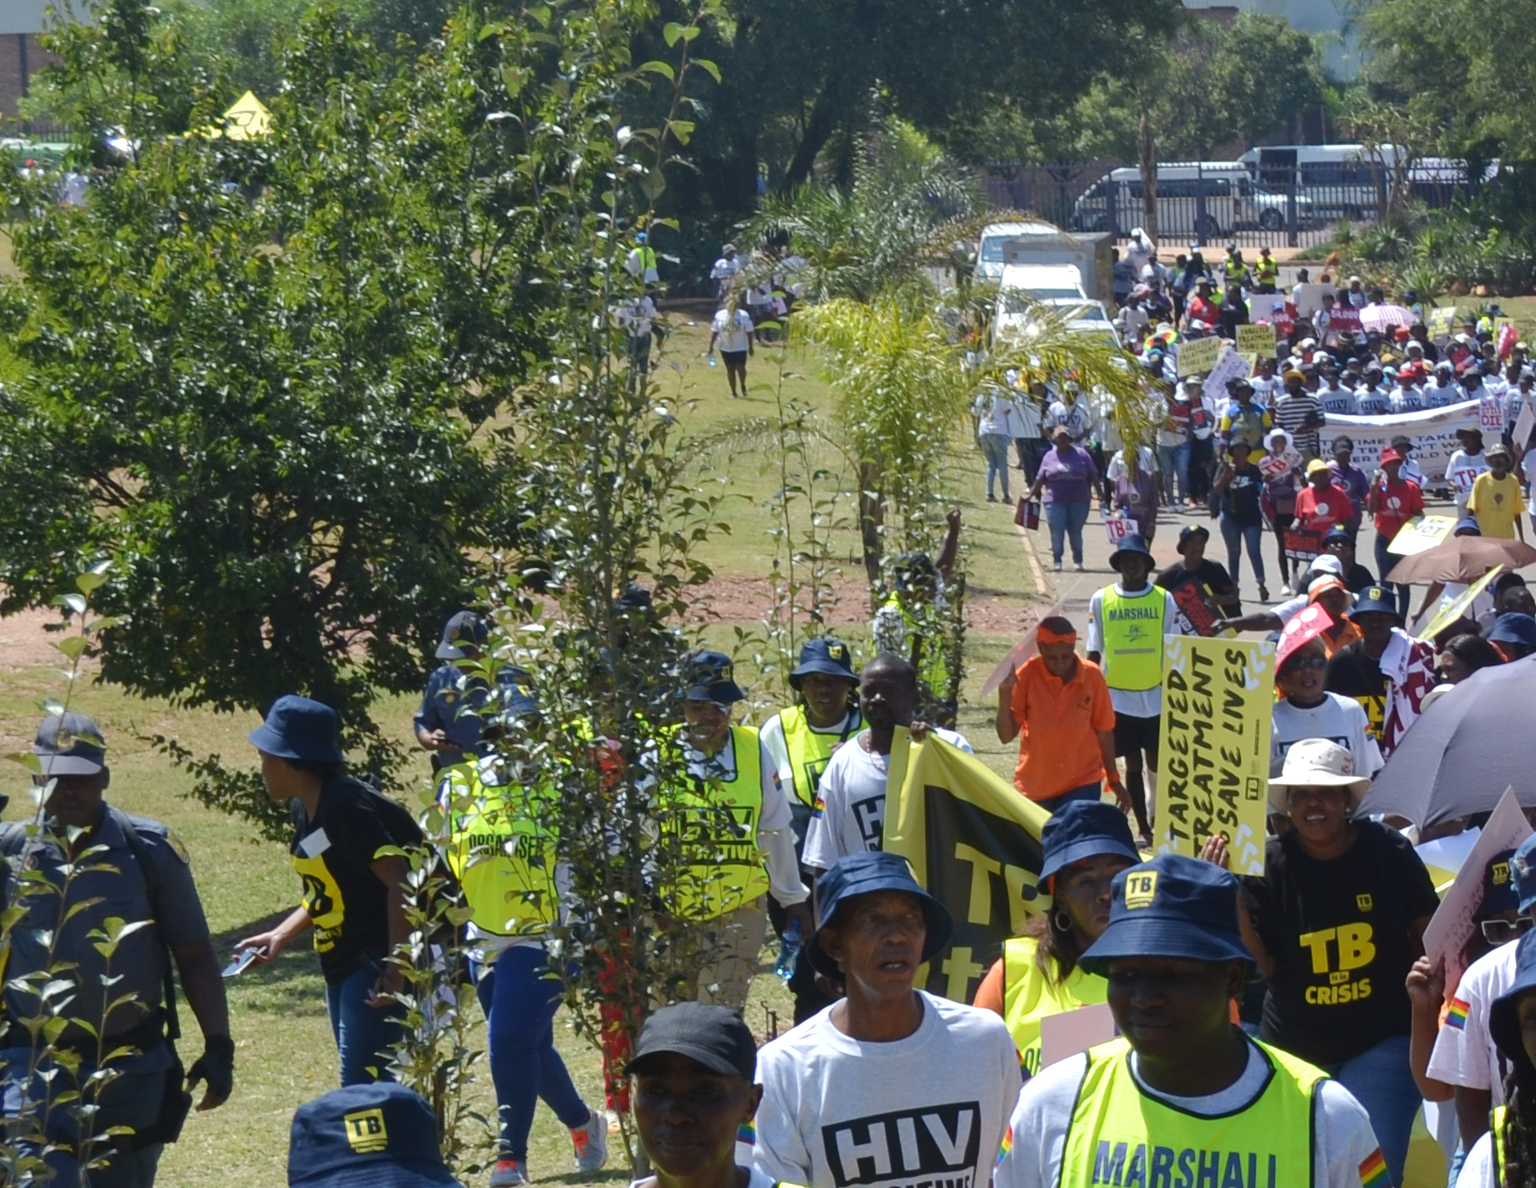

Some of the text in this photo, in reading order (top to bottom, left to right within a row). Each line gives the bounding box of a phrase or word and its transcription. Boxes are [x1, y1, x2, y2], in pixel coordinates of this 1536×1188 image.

[1481, 416, 1503, 426] DIE
[1110, 607, 1159, 621] MARSHALL
[1192, 646, 1214, 857] TREATMENT
[1218, 648, 1247, 828] SAVE LIVES
[1167, 669, 1191, 840] TARGETED
[1494, 864, 1508, 877] TB
[1129, 876, 1153, 895] TB
[1299, 922, 1376, 974] TB
[1305, 978, 1371, 1005] CRISIS
[349, 1115, 381, 1138] TB
[835, 1108, 975, 1182] HIV
